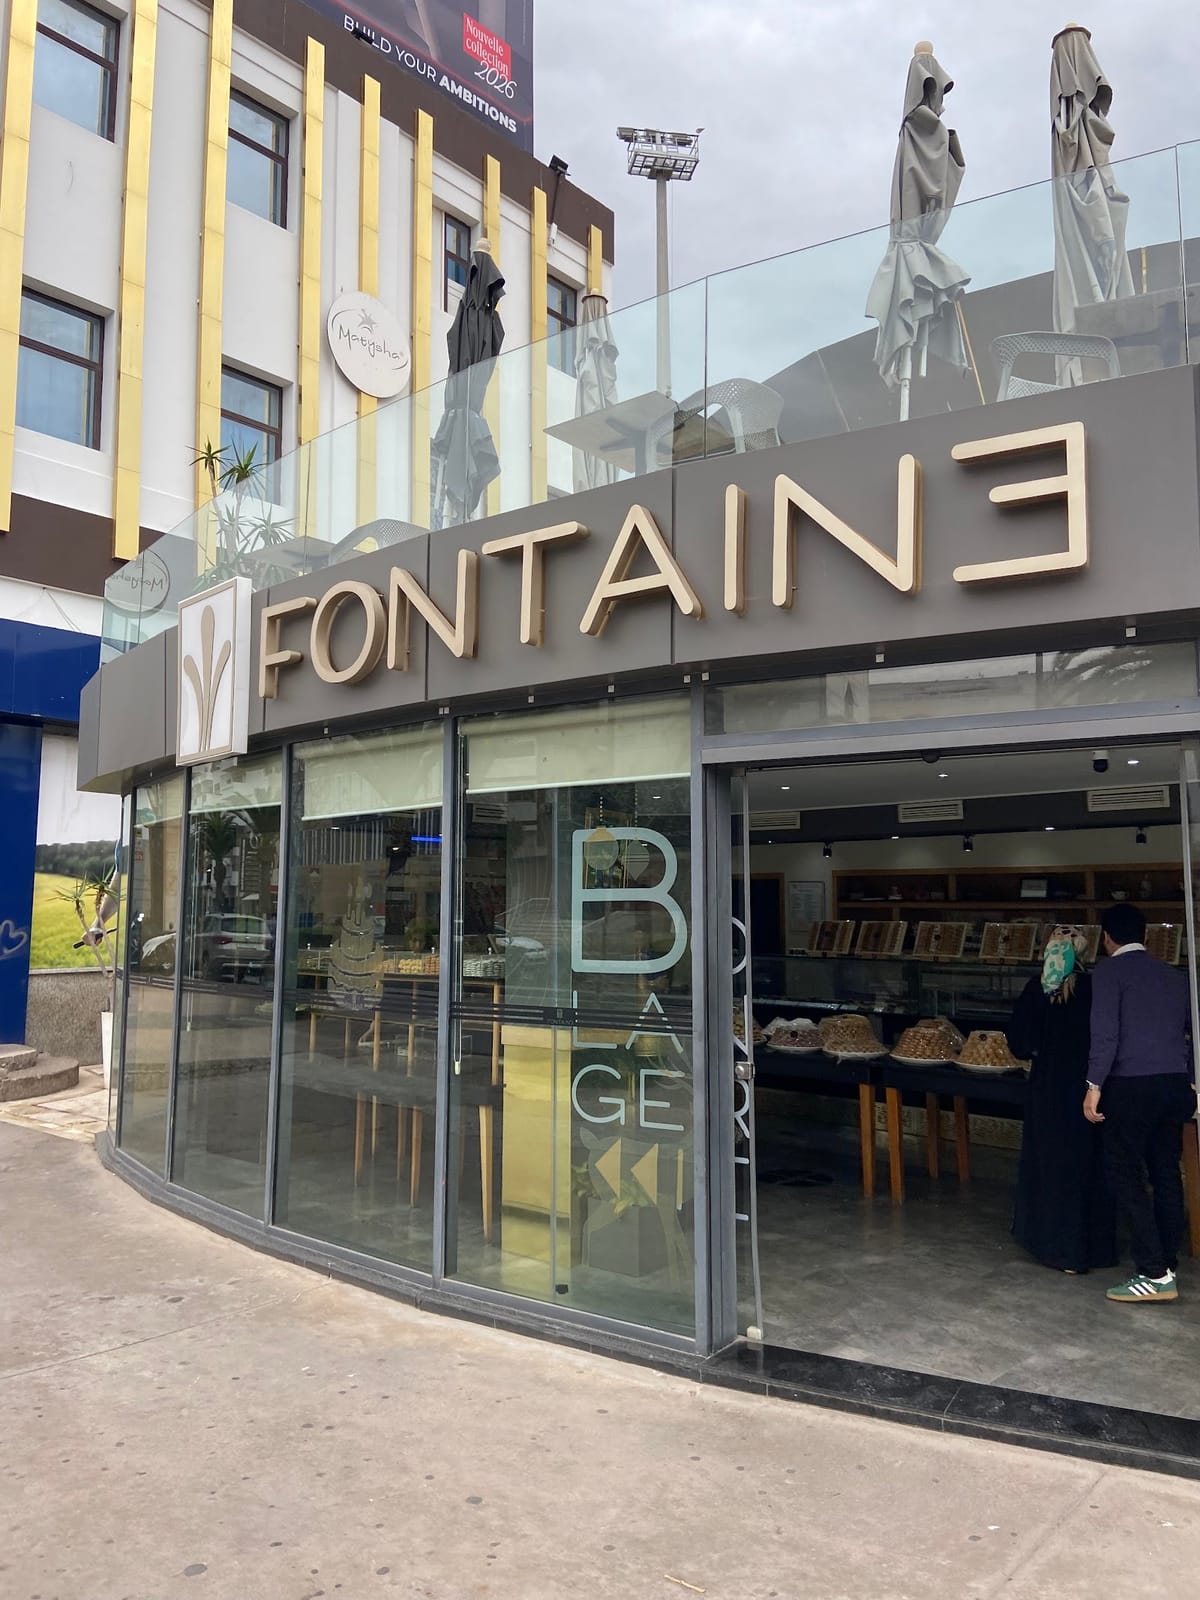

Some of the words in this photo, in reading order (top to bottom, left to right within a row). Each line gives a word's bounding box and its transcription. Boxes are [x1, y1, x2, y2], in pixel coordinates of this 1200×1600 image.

[466, 17, 504, 56] Nouvelle
[465, 38, 509, 76] collection
[394, 46, 437, 82] YOUR
[439, 75, 517, 133] AMBITIONS
[474, 60, 517, 99] 2026
